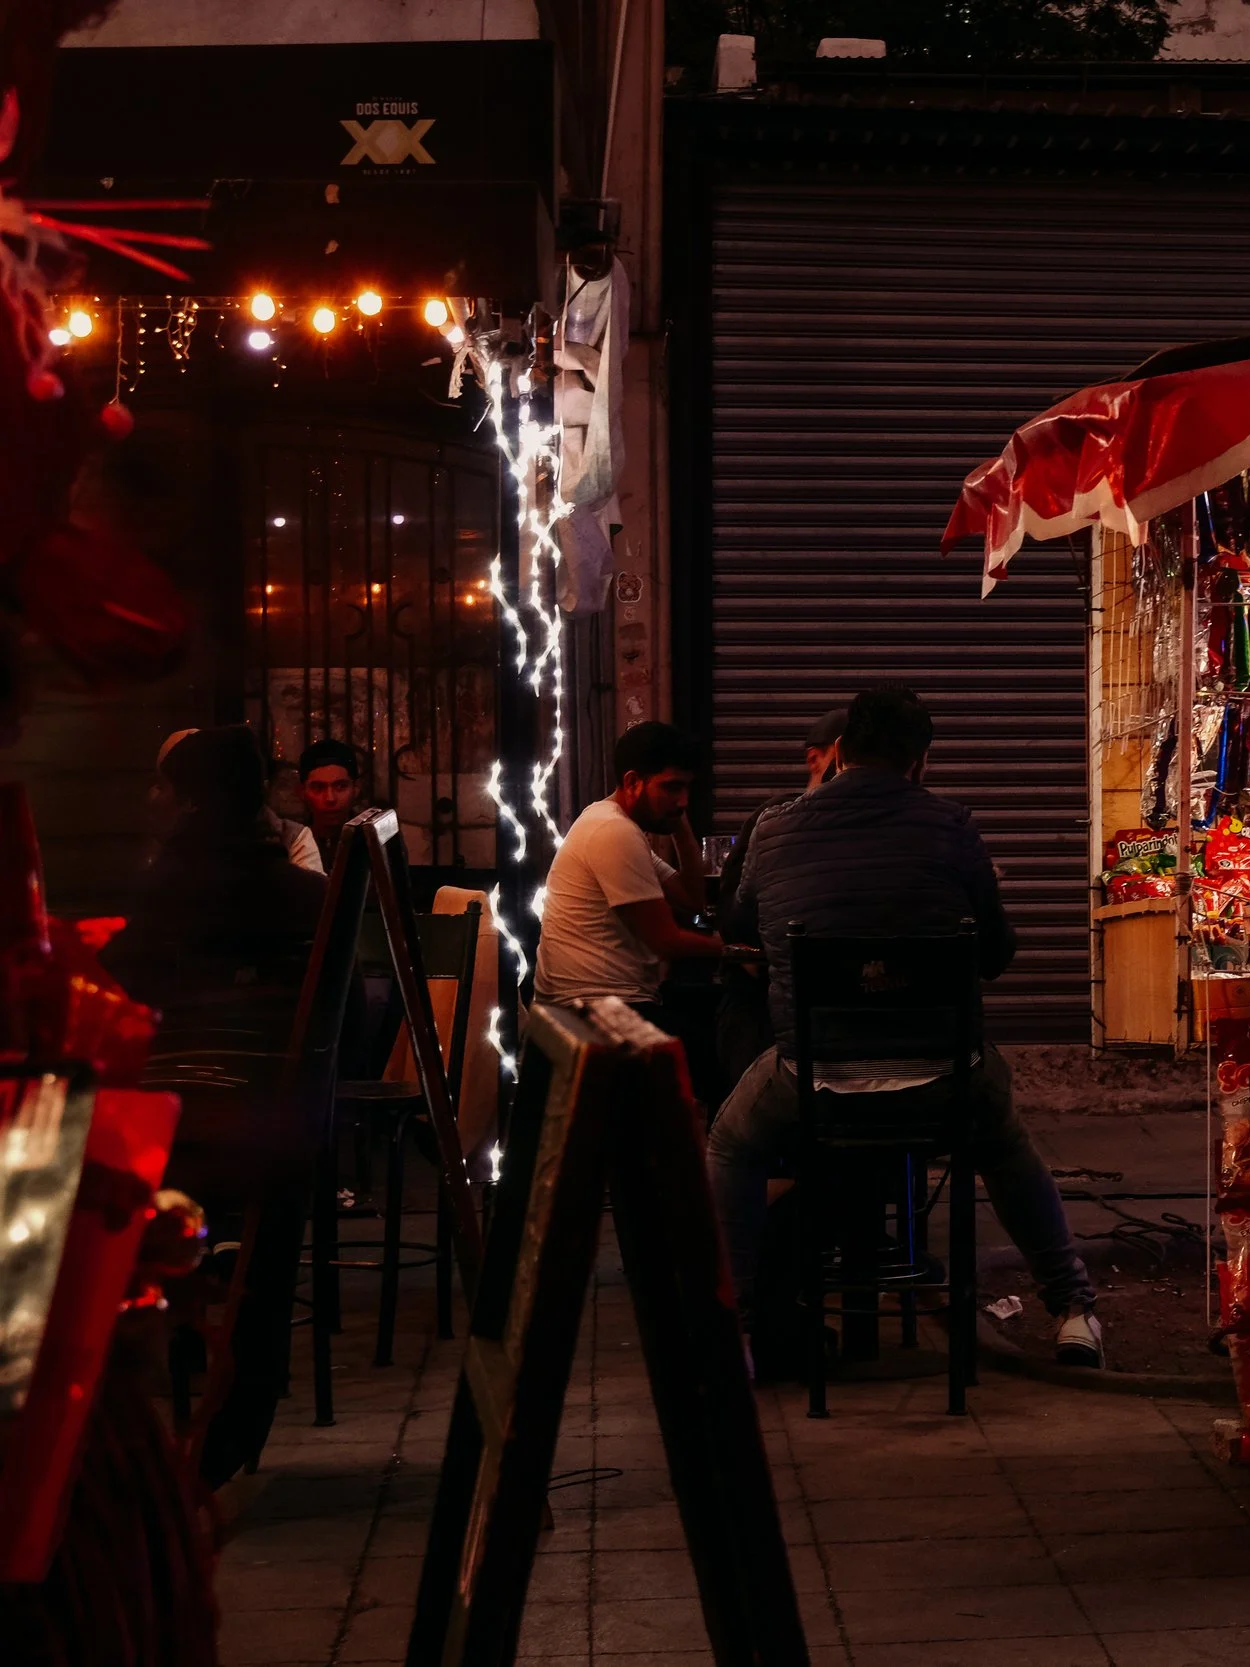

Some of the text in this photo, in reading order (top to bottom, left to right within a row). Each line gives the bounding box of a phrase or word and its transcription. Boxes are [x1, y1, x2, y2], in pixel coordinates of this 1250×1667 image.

[356, 102, 419, 116] DOS EQUIS
[339, 119, 437, 165] XX
